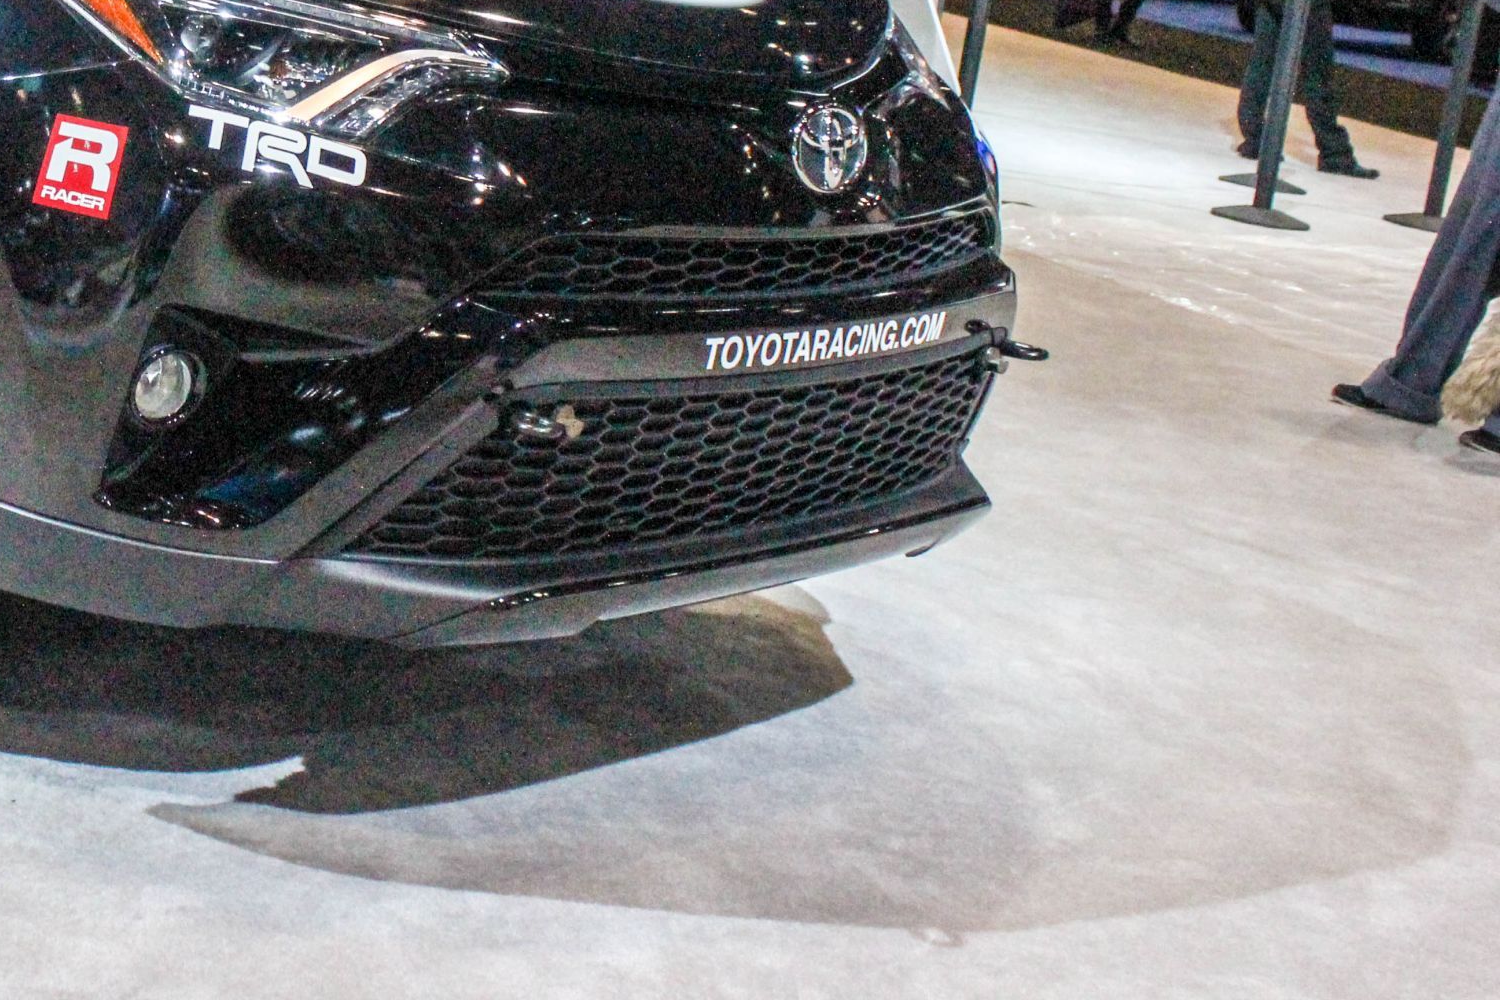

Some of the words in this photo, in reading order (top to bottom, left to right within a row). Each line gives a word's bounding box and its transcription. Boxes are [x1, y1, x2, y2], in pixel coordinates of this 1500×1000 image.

[188, 104, 367, 188] TRD
[41, 184, 105, 211] RACER
[706, 311, 946, 370] TOYOTARACING.COM
